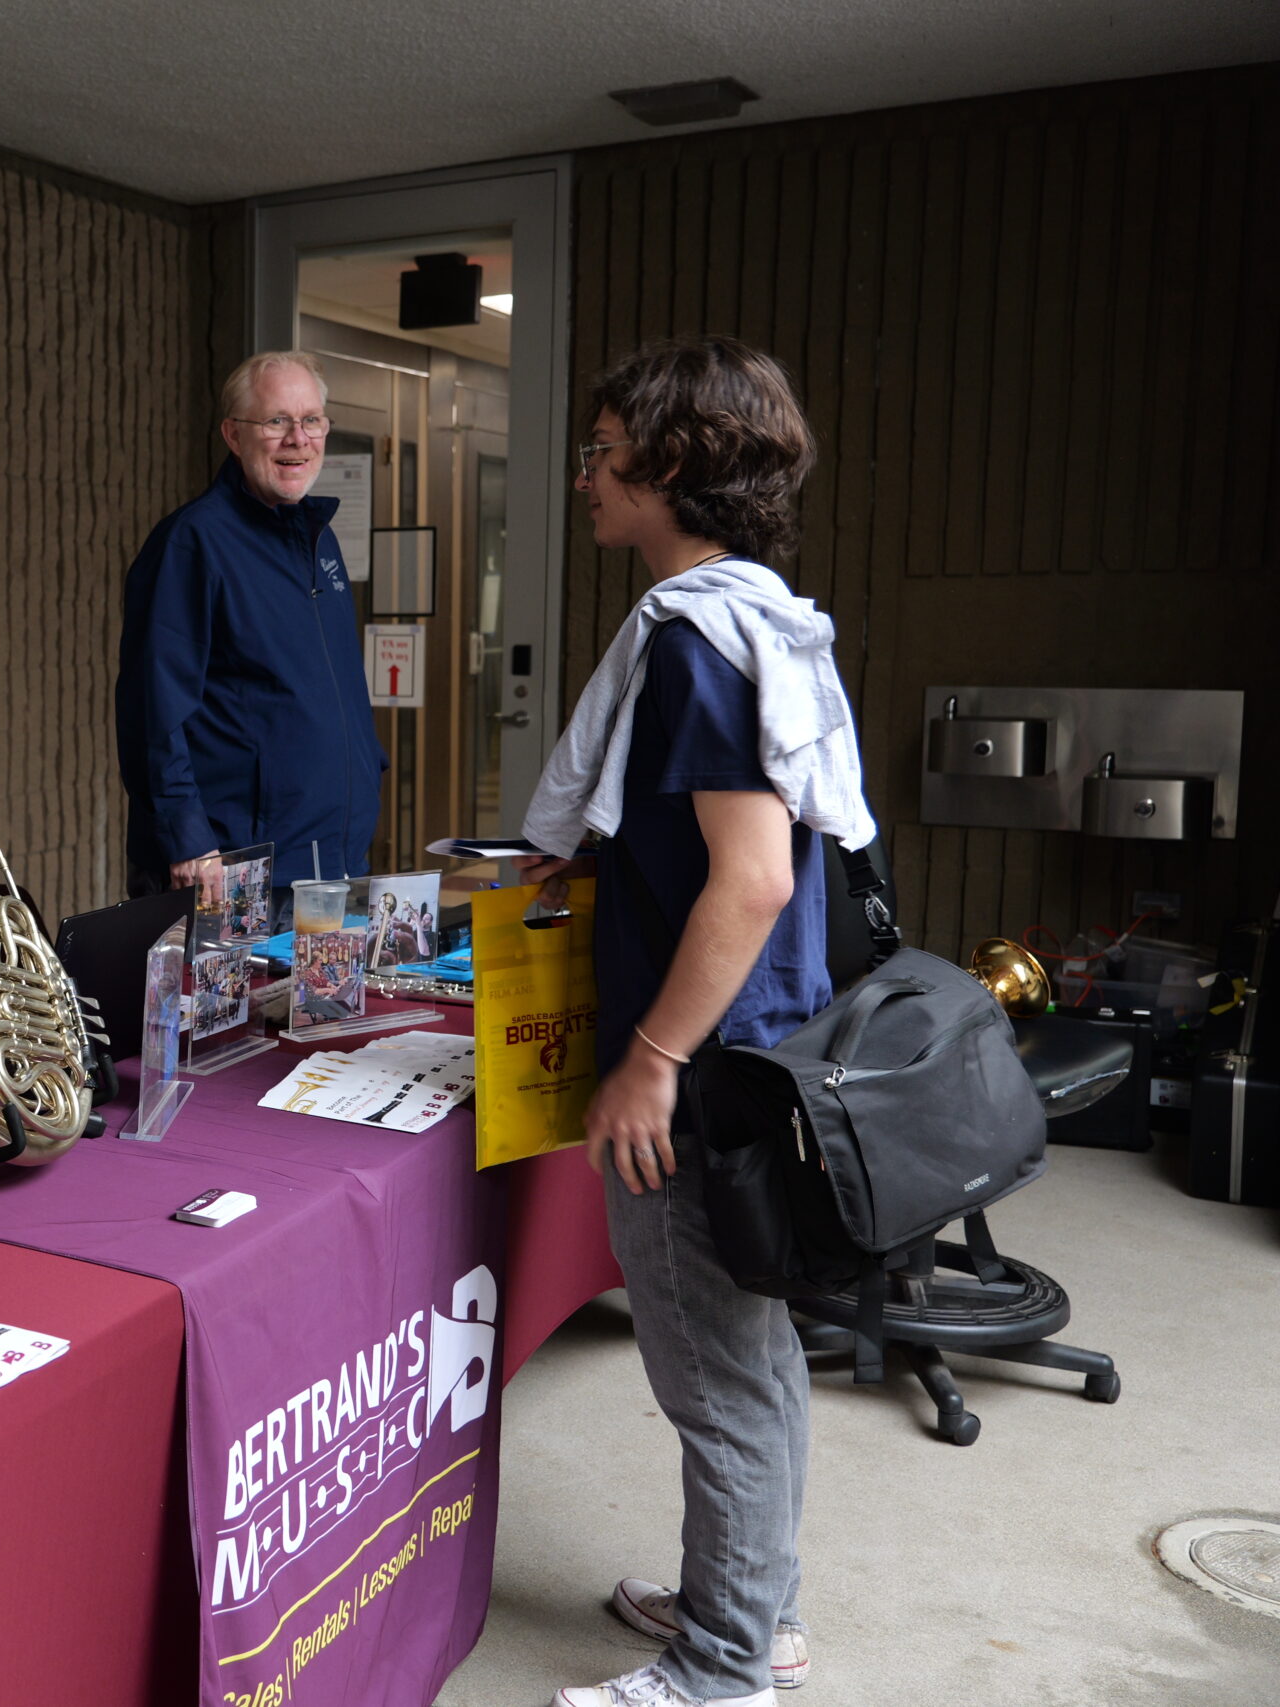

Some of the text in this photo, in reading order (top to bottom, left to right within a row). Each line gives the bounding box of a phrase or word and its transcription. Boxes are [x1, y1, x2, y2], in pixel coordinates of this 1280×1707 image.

[505, 1010, 598, 1046] BOBCATS
[223, 1309, 424, 1521] BERTRAND'S
[292, 1599, 350, 1680] Rentals
[359, 1533, 417, 1609] Lessons
